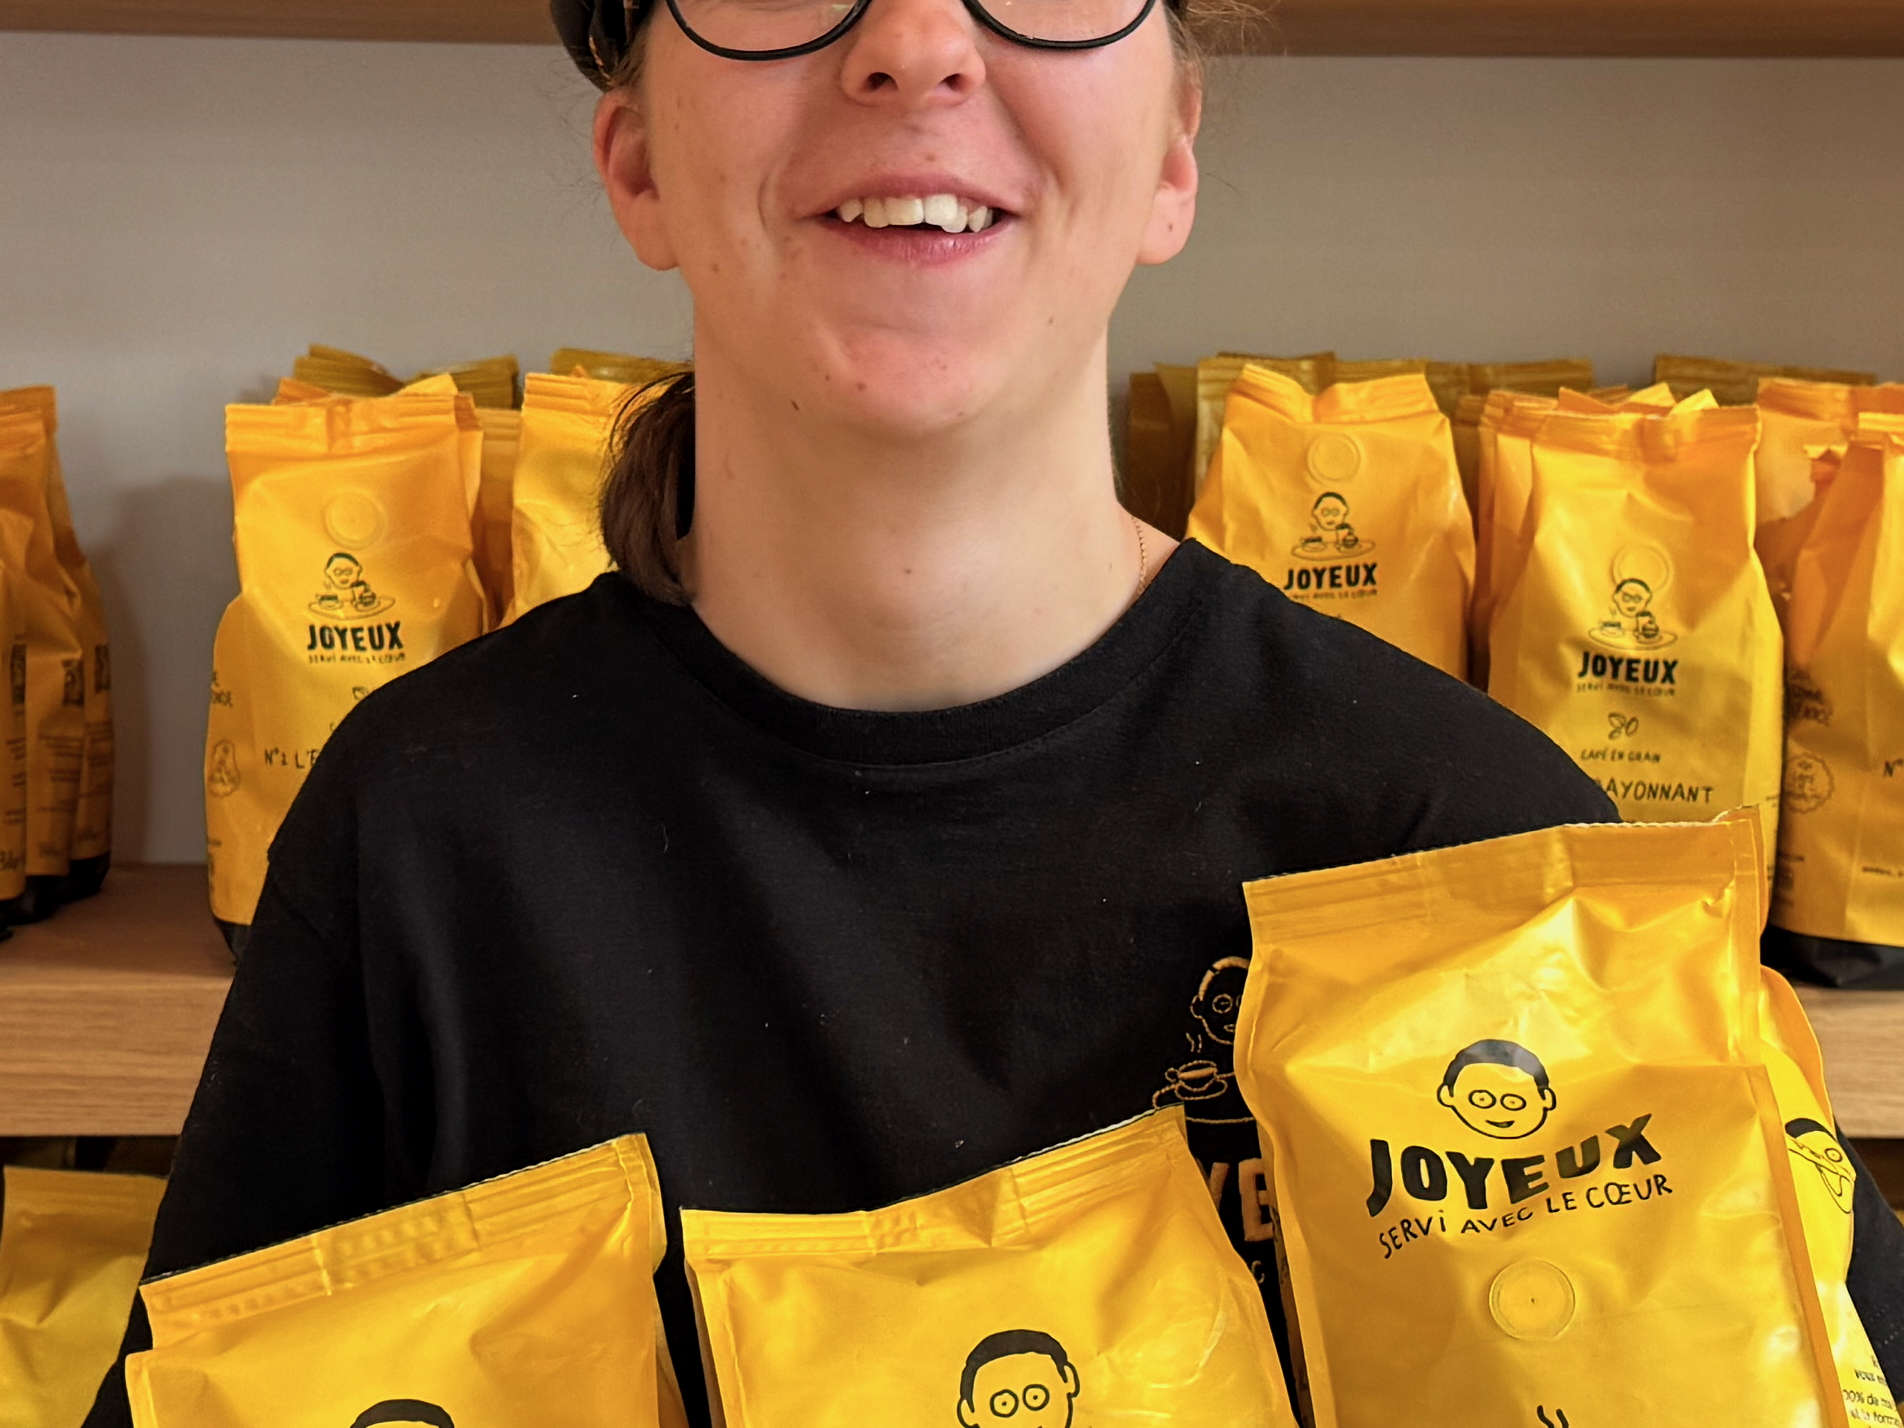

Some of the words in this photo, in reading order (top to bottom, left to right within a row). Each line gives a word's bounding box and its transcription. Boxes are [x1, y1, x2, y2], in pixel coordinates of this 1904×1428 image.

[1283, 563, 1377, 594] JOYEUX
[307, 621, 403, 652] JOYEUX
[1578, 651, 1678, 685] JOYEUX
[1367, 1114, 1662, 1218] JOYEUX
[1461, 1207, 1533, 1233] AVEC
[1546, 1192, 1577, 1213] LE
[1586, 1174, 1673, 1208] CŒUR
